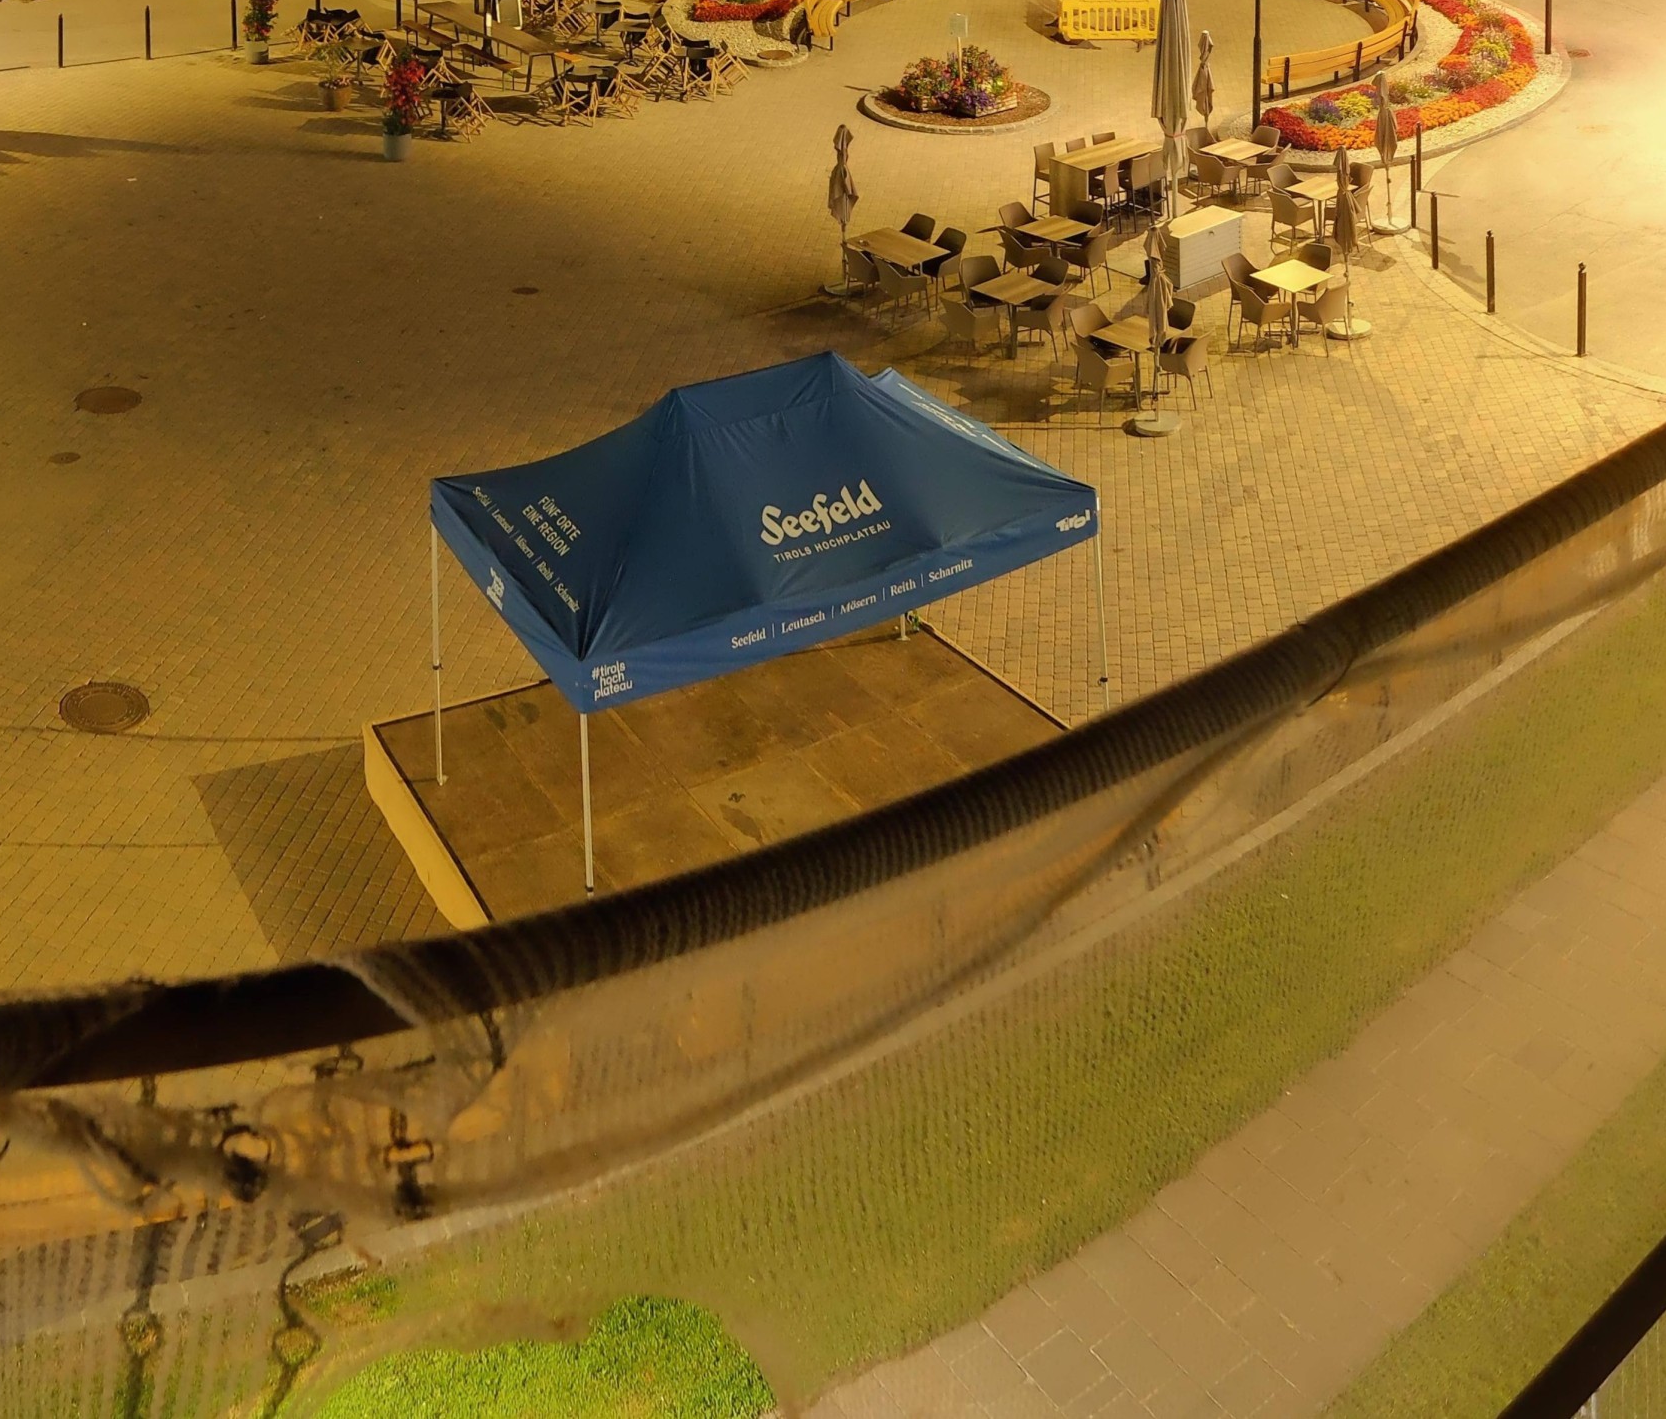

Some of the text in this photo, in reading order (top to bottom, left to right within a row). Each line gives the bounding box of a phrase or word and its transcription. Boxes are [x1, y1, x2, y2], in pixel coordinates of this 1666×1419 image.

[522, 505, 571, 557] EINE REGION
[537, 495, 581, 541] FÜNF ORTE
[761, 478, 882, 546] Seefeld
[1055, 509, 1091, 532] Tirol
[773, 520, 892, 563] TIROLS HOCHPLATEAU
[731, 558, 973, 650] Seefeld Leutasch Mösern Reith Scharnitz
[591, 661, 626, 680] #tirols
[594, 680, 633, 701] plateau
[600, 671, 625, 686] hoch
